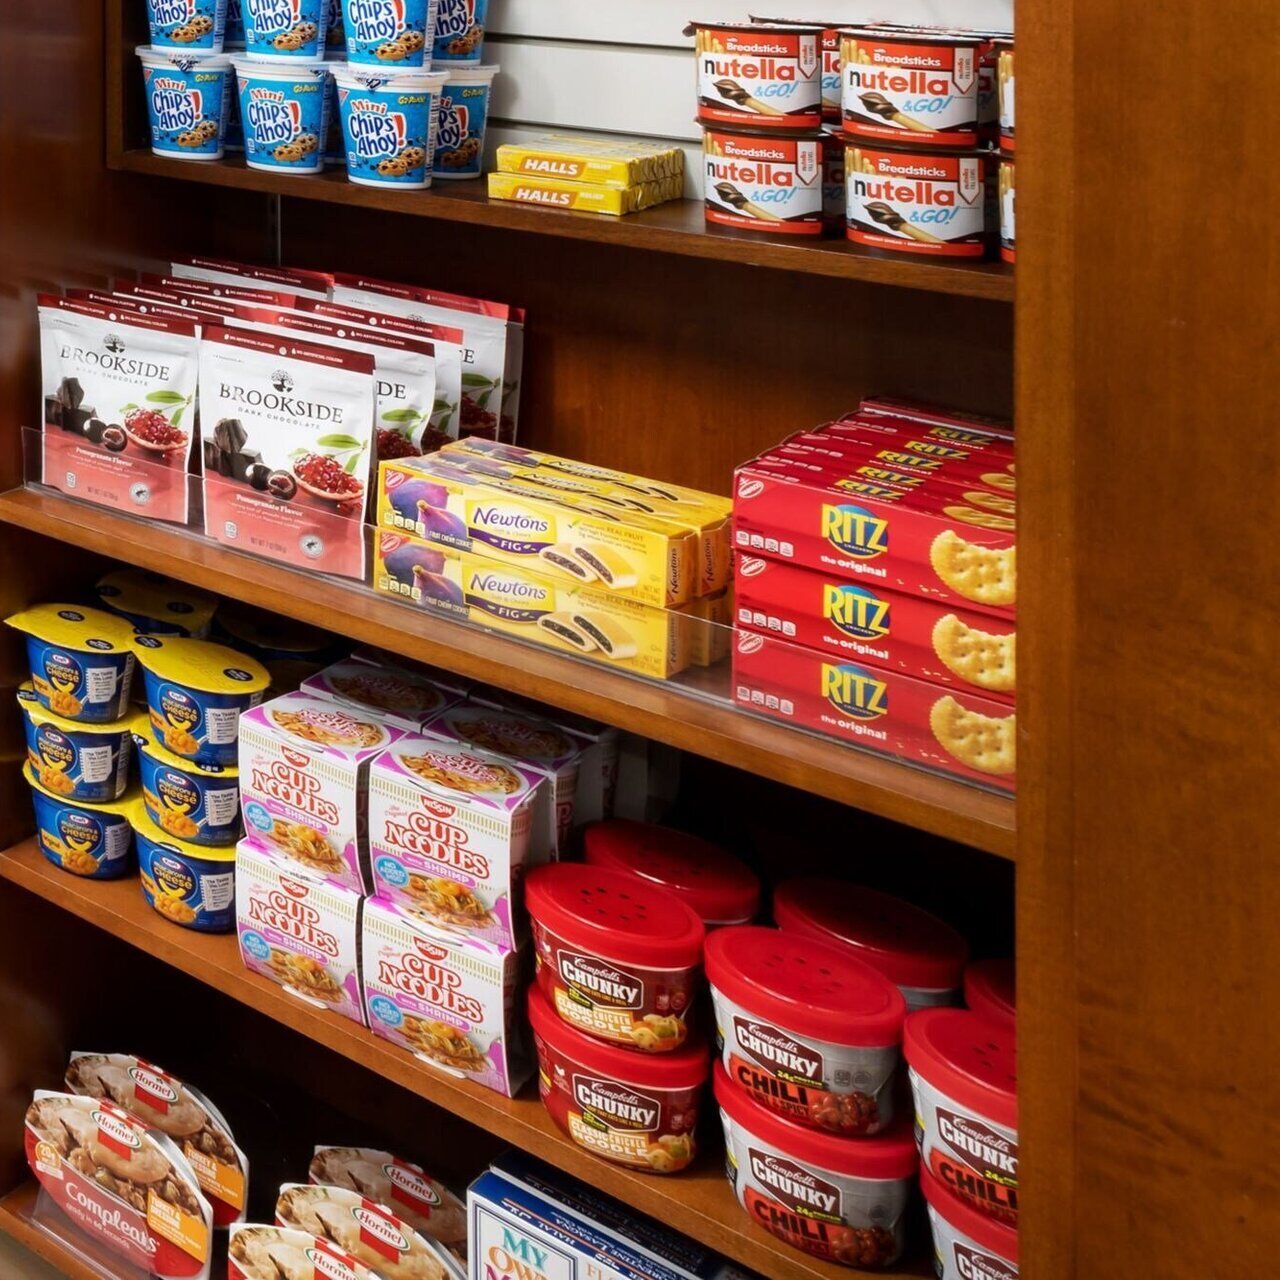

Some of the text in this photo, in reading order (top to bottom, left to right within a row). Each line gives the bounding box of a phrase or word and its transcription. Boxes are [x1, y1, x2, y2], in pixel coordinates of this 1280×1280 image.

[727, 42, 787, 53] Breadsticks
[873, 53, 941, 66] Breadsticks
[704, 58, 795, 80] nutella
[850, 68, 949, 95] nutella
[525, 158, 578, 176] HALLS
[707, 161, 793, 186] nutella
[515, 188, 571, 205] HALLS
[61, 344, 170, 381] BROOKSIDE
[219, 382, 344, 424] BROOKSIDE
[238, 406, 263, 417] DARK
[279, 506, 304, 518] Flavor
[472, 507, 549, 532] Newtons
[821, 504, 888, 552] RITZ
[500, 541, 522, 552] FIG
[820, 555, 887, 578] the original
[469, 574, 547, 600] Newtons
[499, 608, 520, 619] FIG
[823, 583, 890, 637] RITZ
[271, 762, 320, 794] CUP
[252, 769, 340, 826] NOODLES
[284, 807, 324, 829] SHRIMP
[562, 960, 638, 1003] CHUNKY
[574, 956, 620, 982] Campbell's
[557, 999, 592, 1018] CLASSIC
[564, 1007, 632, 1033] NOODLE
[131, 1068, 177, 1103] Hormel
[739, 1067, 809, 1107] CHILI
[577, 1081, 656, 1129] CHUNKY
[65, 1182, 158, 1254] Compleats
[501, 1228, 548, 1270] MY
